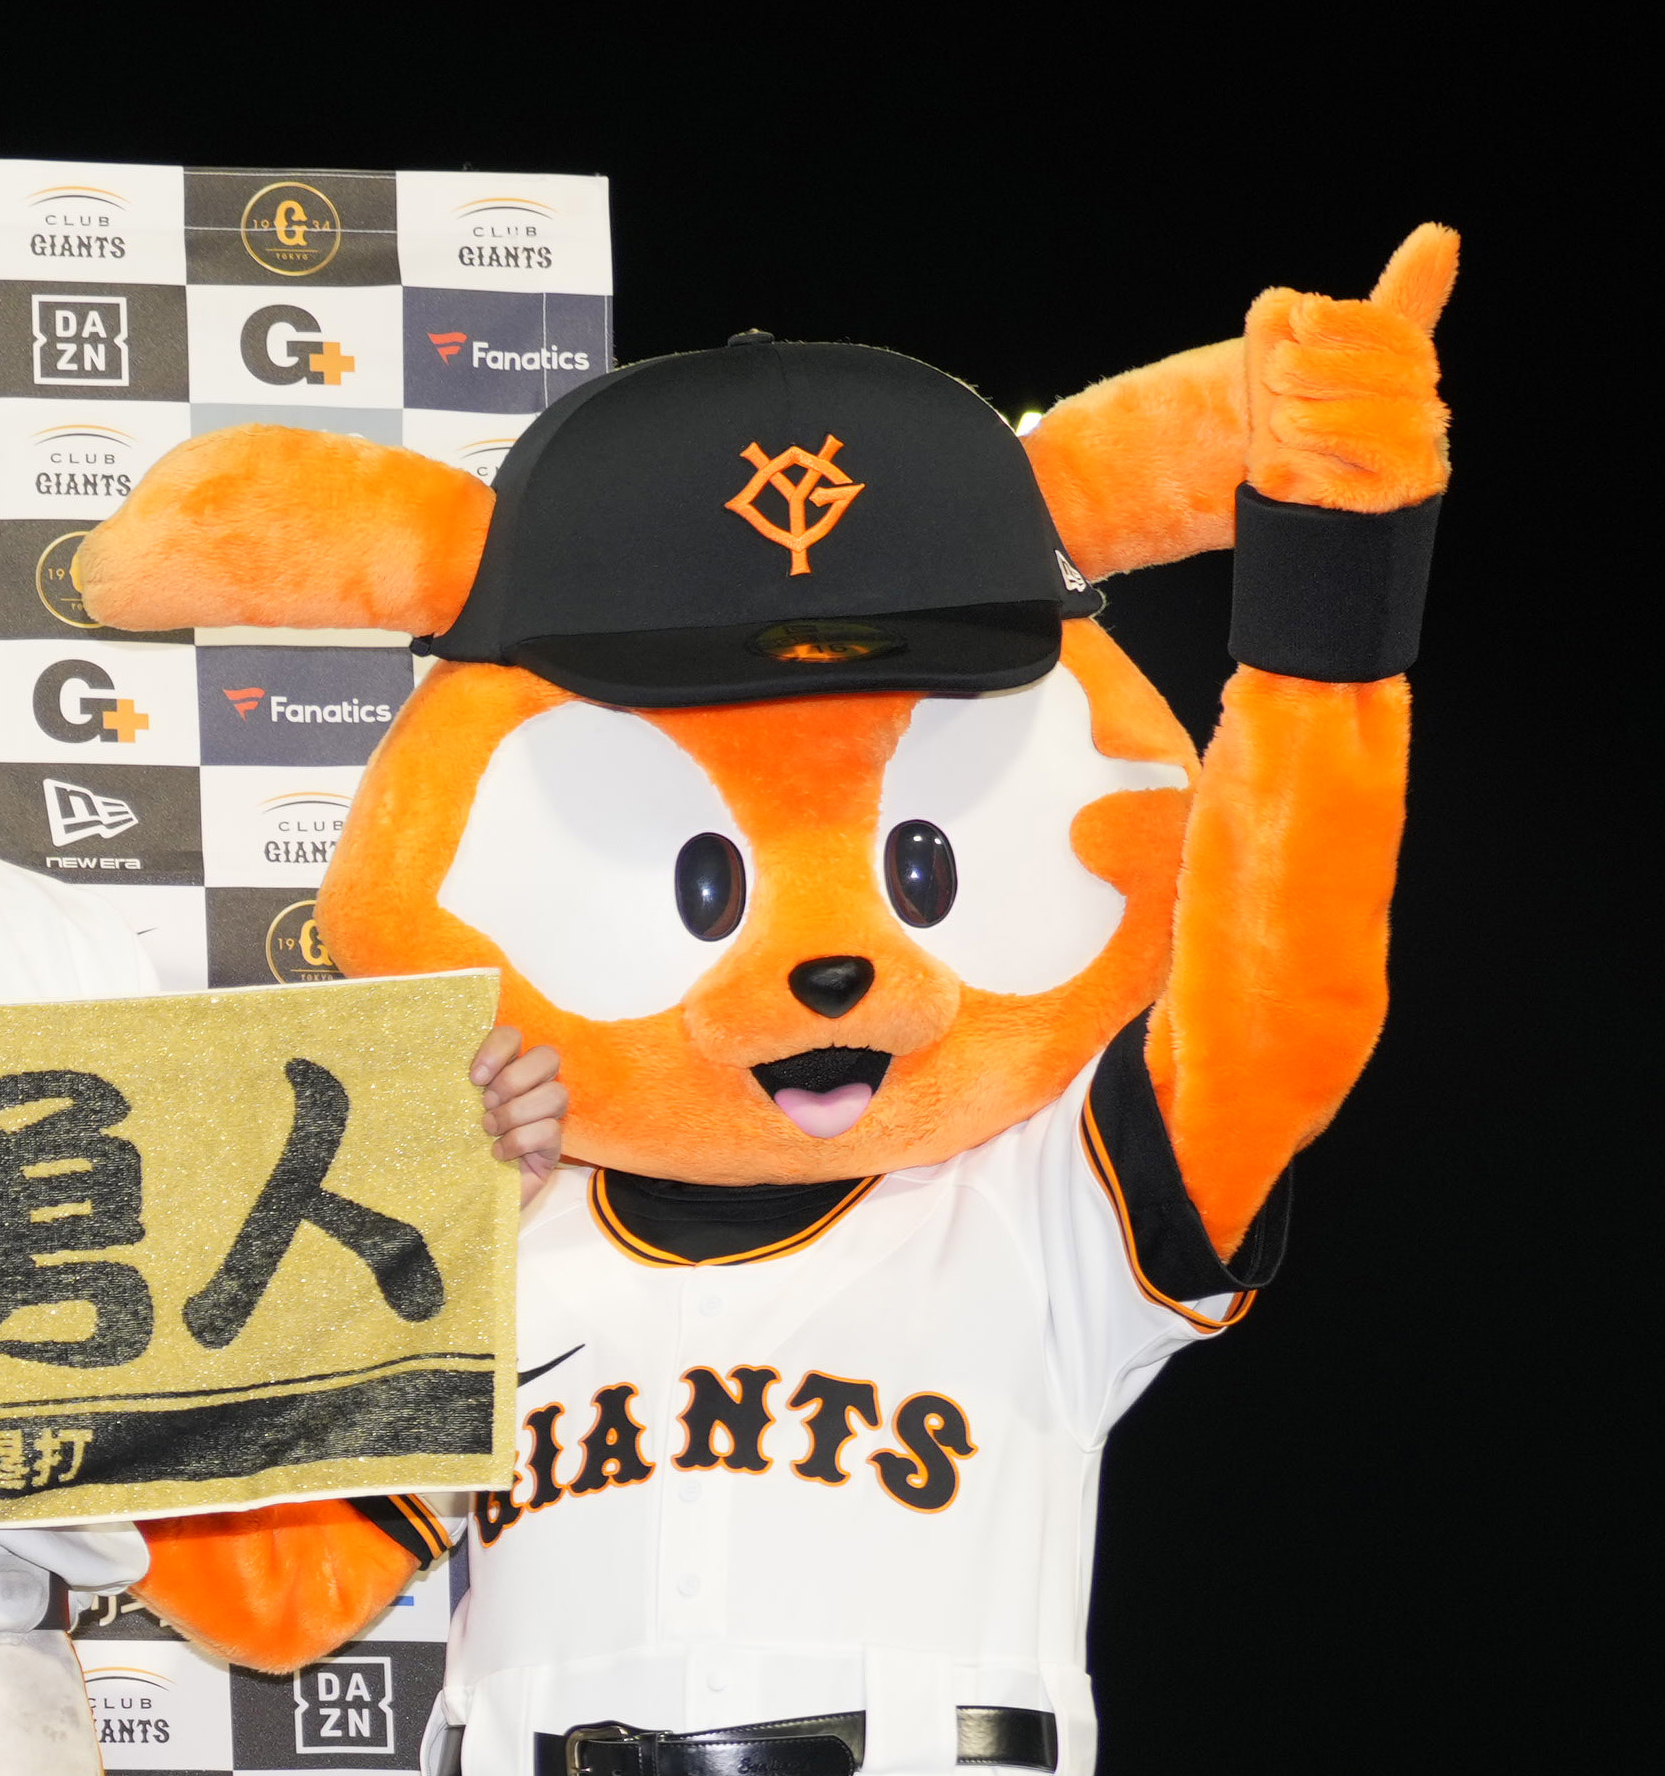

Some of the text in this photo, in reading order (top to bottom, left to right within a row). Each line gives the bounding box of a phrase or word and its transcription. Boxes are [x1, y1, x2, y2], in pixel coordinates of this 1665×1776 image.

[44, 214, 109, 227] CLUB
[29, 233, 125, 258] GIANTS
[472, 336, 590, 372] Fanatics
[49, 452, 115, 464] CLUB
[34, 471, 131, 497] GIANTS
[270, 695, 392, 723] Fanatics
